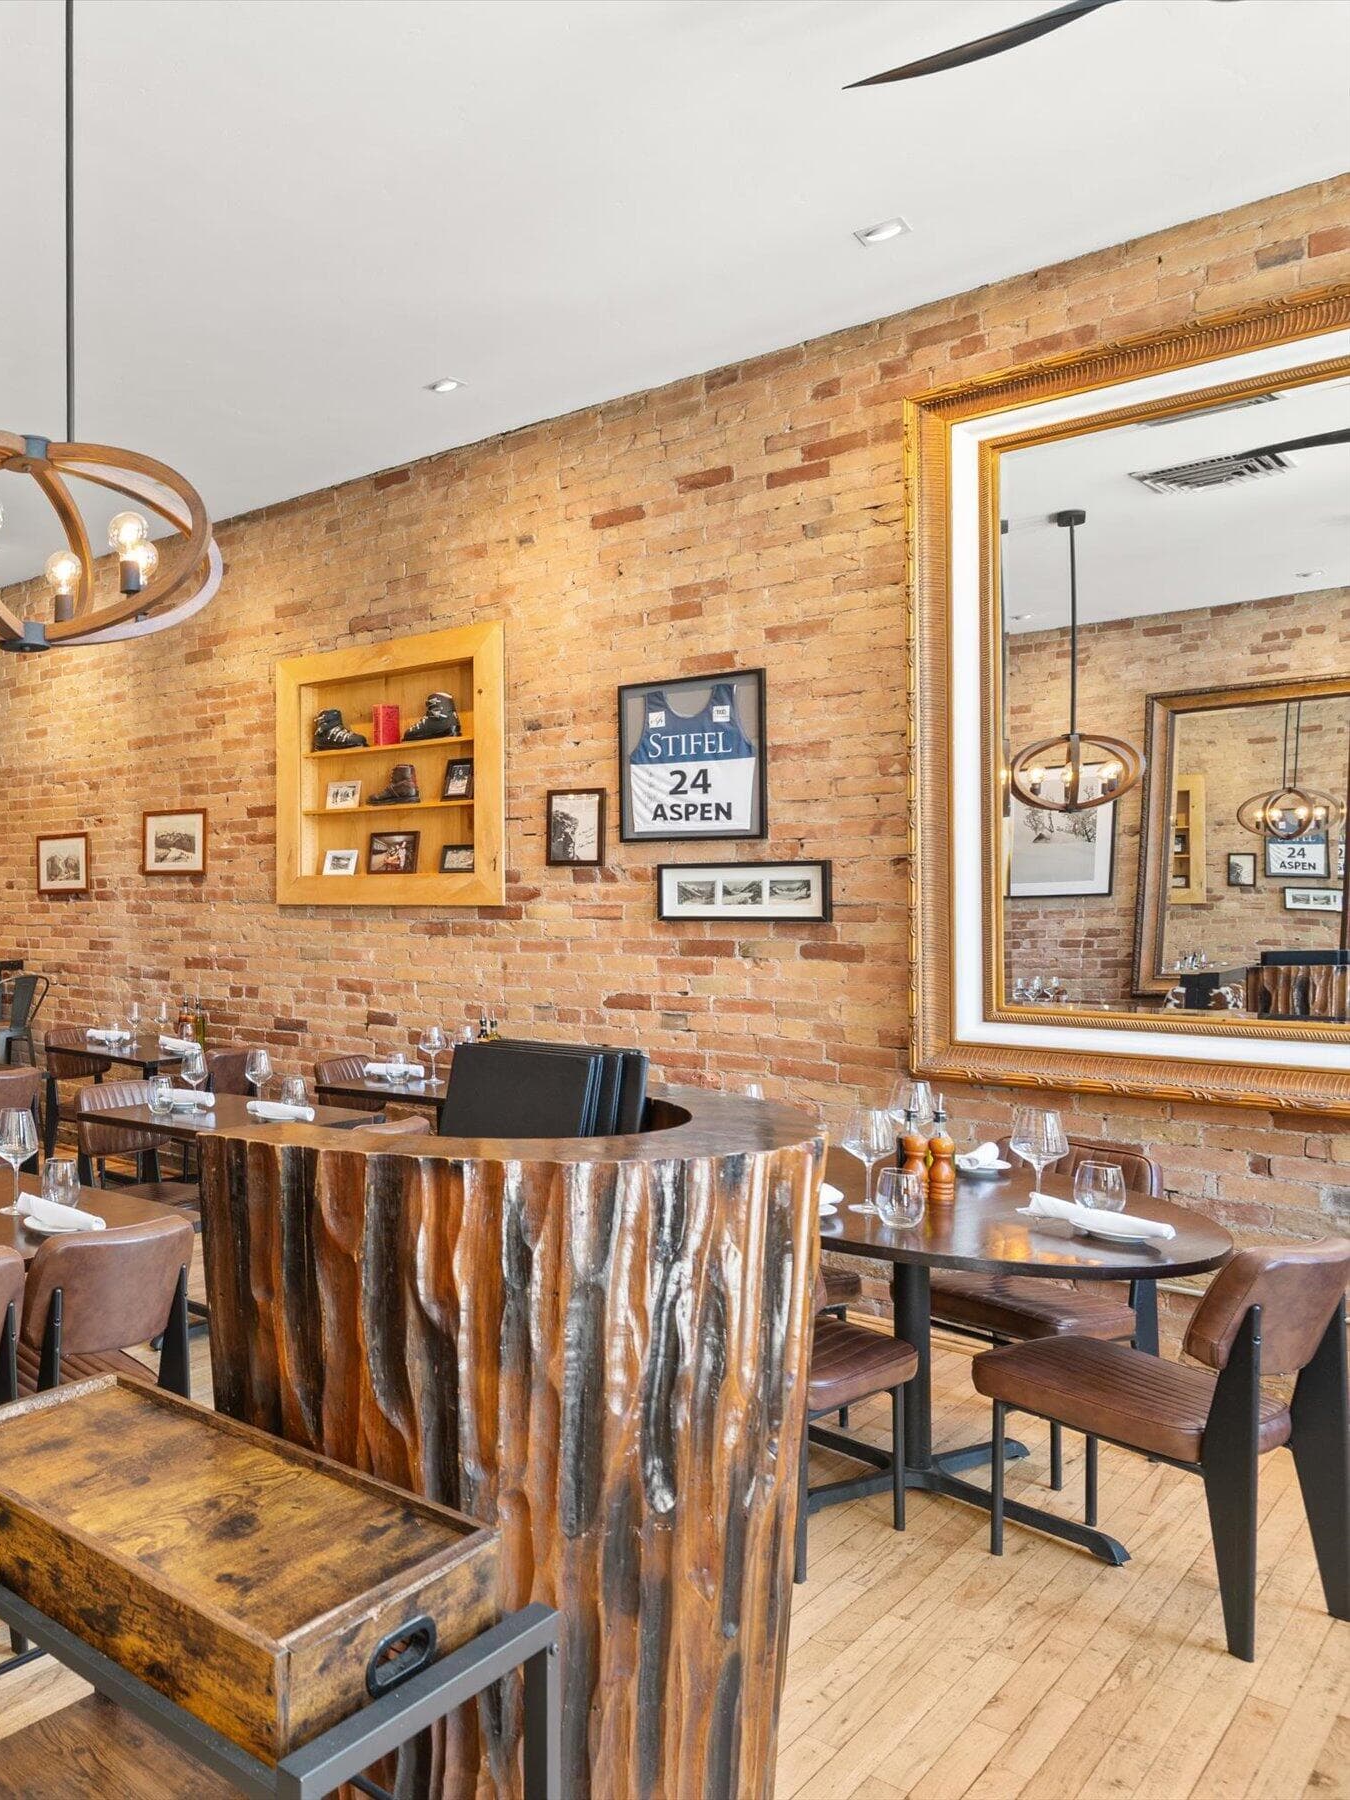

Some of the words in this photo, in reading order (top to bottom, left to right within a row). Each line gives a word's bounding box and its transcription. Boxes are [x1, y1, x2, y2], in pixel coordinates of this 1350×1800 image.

[648, 732, 732, 758] STIFEL
[669, 768, 711, 795] 24
[652, 802, 732, 821] ASPEN
[1287, 847, 1306, 859] 24
[1279, 861, 1317, 871] ASPEN
